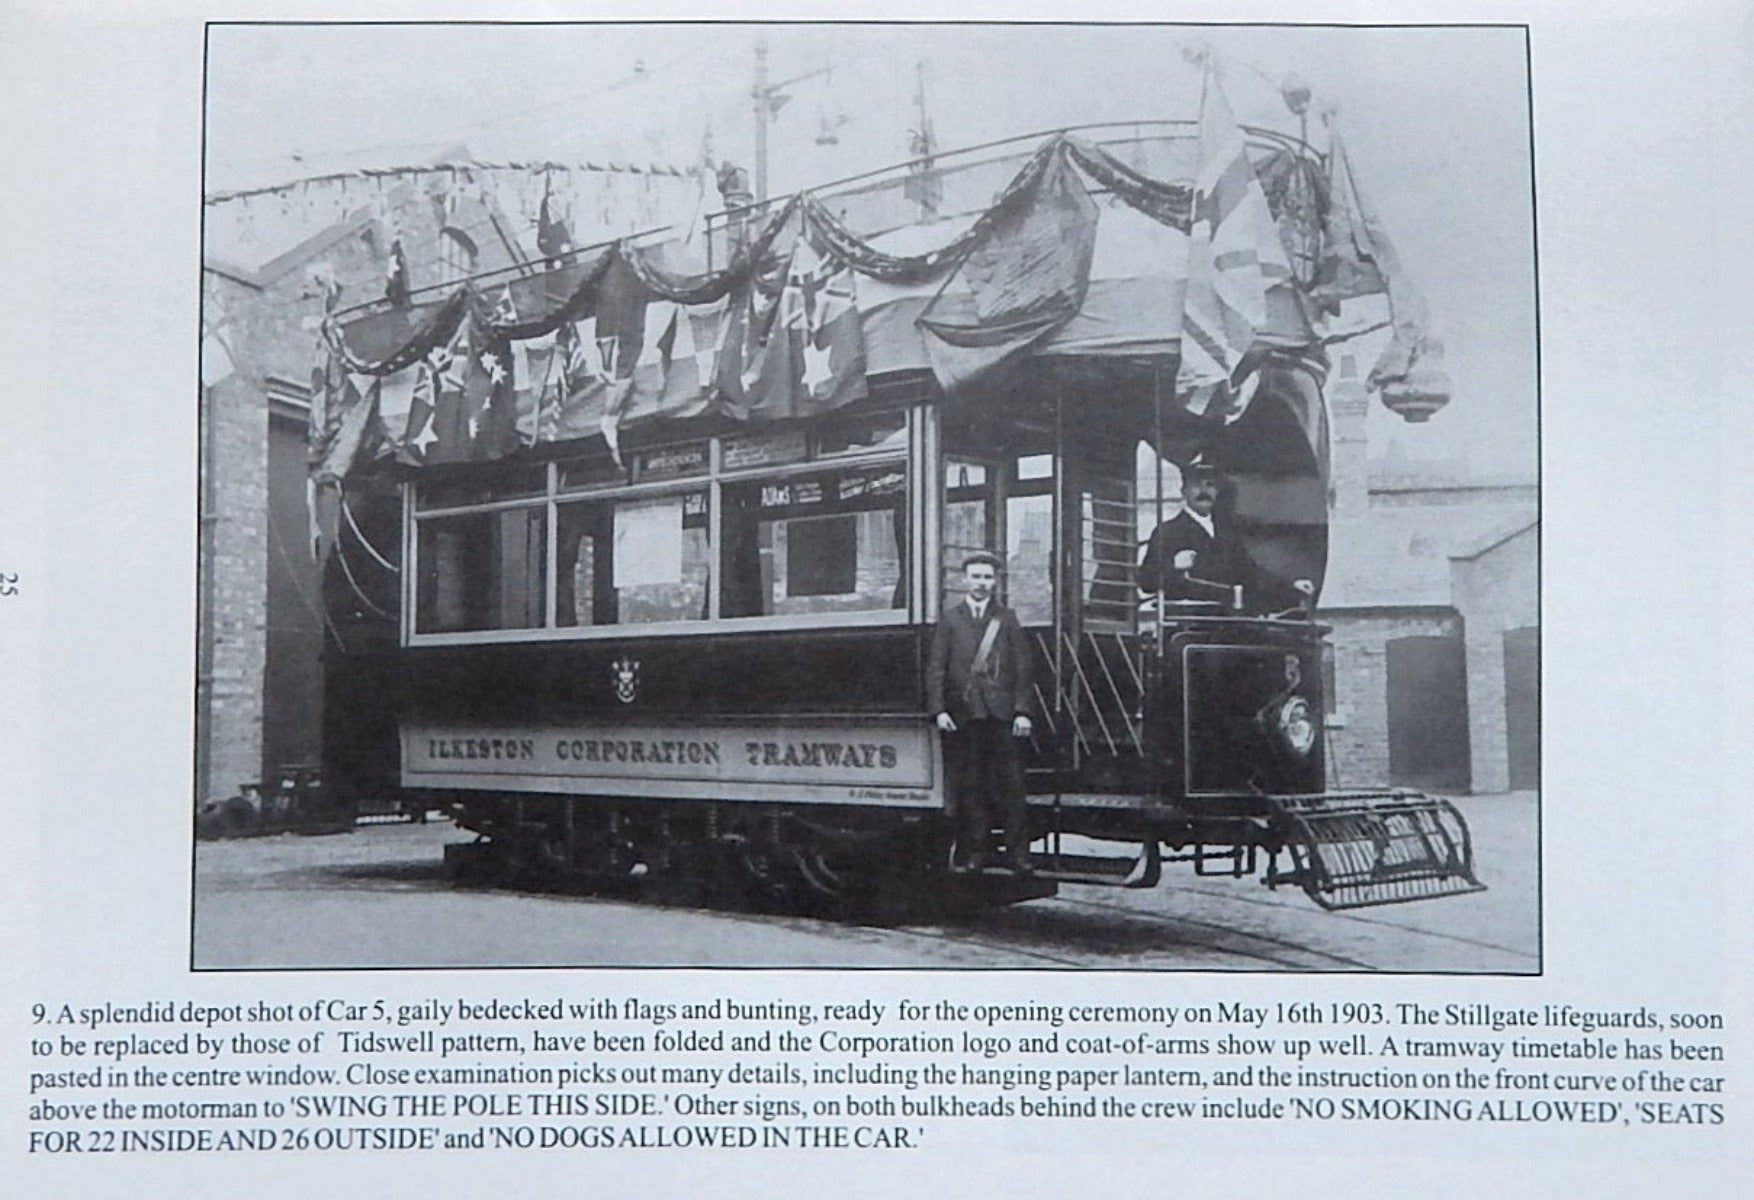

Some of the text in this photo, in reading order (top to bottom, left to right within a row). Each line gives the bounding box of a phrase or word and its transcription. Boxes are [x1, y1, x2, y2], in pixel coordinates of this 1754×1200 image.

[0, 572, 19, 596] 25
[429, 739, 898, 769] ILKESTON CORPORATION TRAMWAYS
[31, 996, 1724, 1034] 9. A splendid depot shot of Car 5, gaily bedecked with flags and bunting, ready for the opening ceremony on May 16th 1903. The Stillgate lifeguards, soon
[30, 1028, 1725, 1064] to be replaced by those of Tidswell pattern, have been folded and the Corporation logo and coat-of-arms show up well. A tramway timetable has been
[29, 1060, 1726, 1095] pasted in the centre window. Close examination picks out many details, including the hanging paper lantern, and the instruction on the front curve of the car
[28, 1098, 98, 1121] above
[102, 1097, 138, 1121] the
[141, 1100, 259, 1120] motorman
[262, 1099, 286, 1119] to
[391, 1093, 448, 1118] THE
[452, 1093, 524, 1117] POLE
[526, 1092, 590, 1117] THIS
[673, 1093, 740, 1116] Other
[742, 1092, 808, 1123] signs,
[812, 1100, 842, 1117] on
[845, 1093, 897, 1117] both
[900, 1094, 1016, 1118] bulkheads
[1019, 1094, 1097, 1118] behind
[1101, 1095, 1137, 1119] the
[1140, 1102, 1197, 1119] crew
[1201, 1095, 1285, 1120] include
[1340, 1097, 1473, 1122] SMOKING
[28, 1130, 85, 1154] FOR
[87, 1129, 116, 1153] 22
[120, 1129, 214, 1153] INSIDE
[214, 1128, 278, 1152] AND
[281, 1127, 310, 1151] 26
[443, 1125, 485, 1150] and
[538, 1125, 616, 1149] DOGS
[617, 1125, 758, 1149] ALLOWED
[762, 1125, 791, 1149] IN
[794, 1125, 850, 1149] THE
